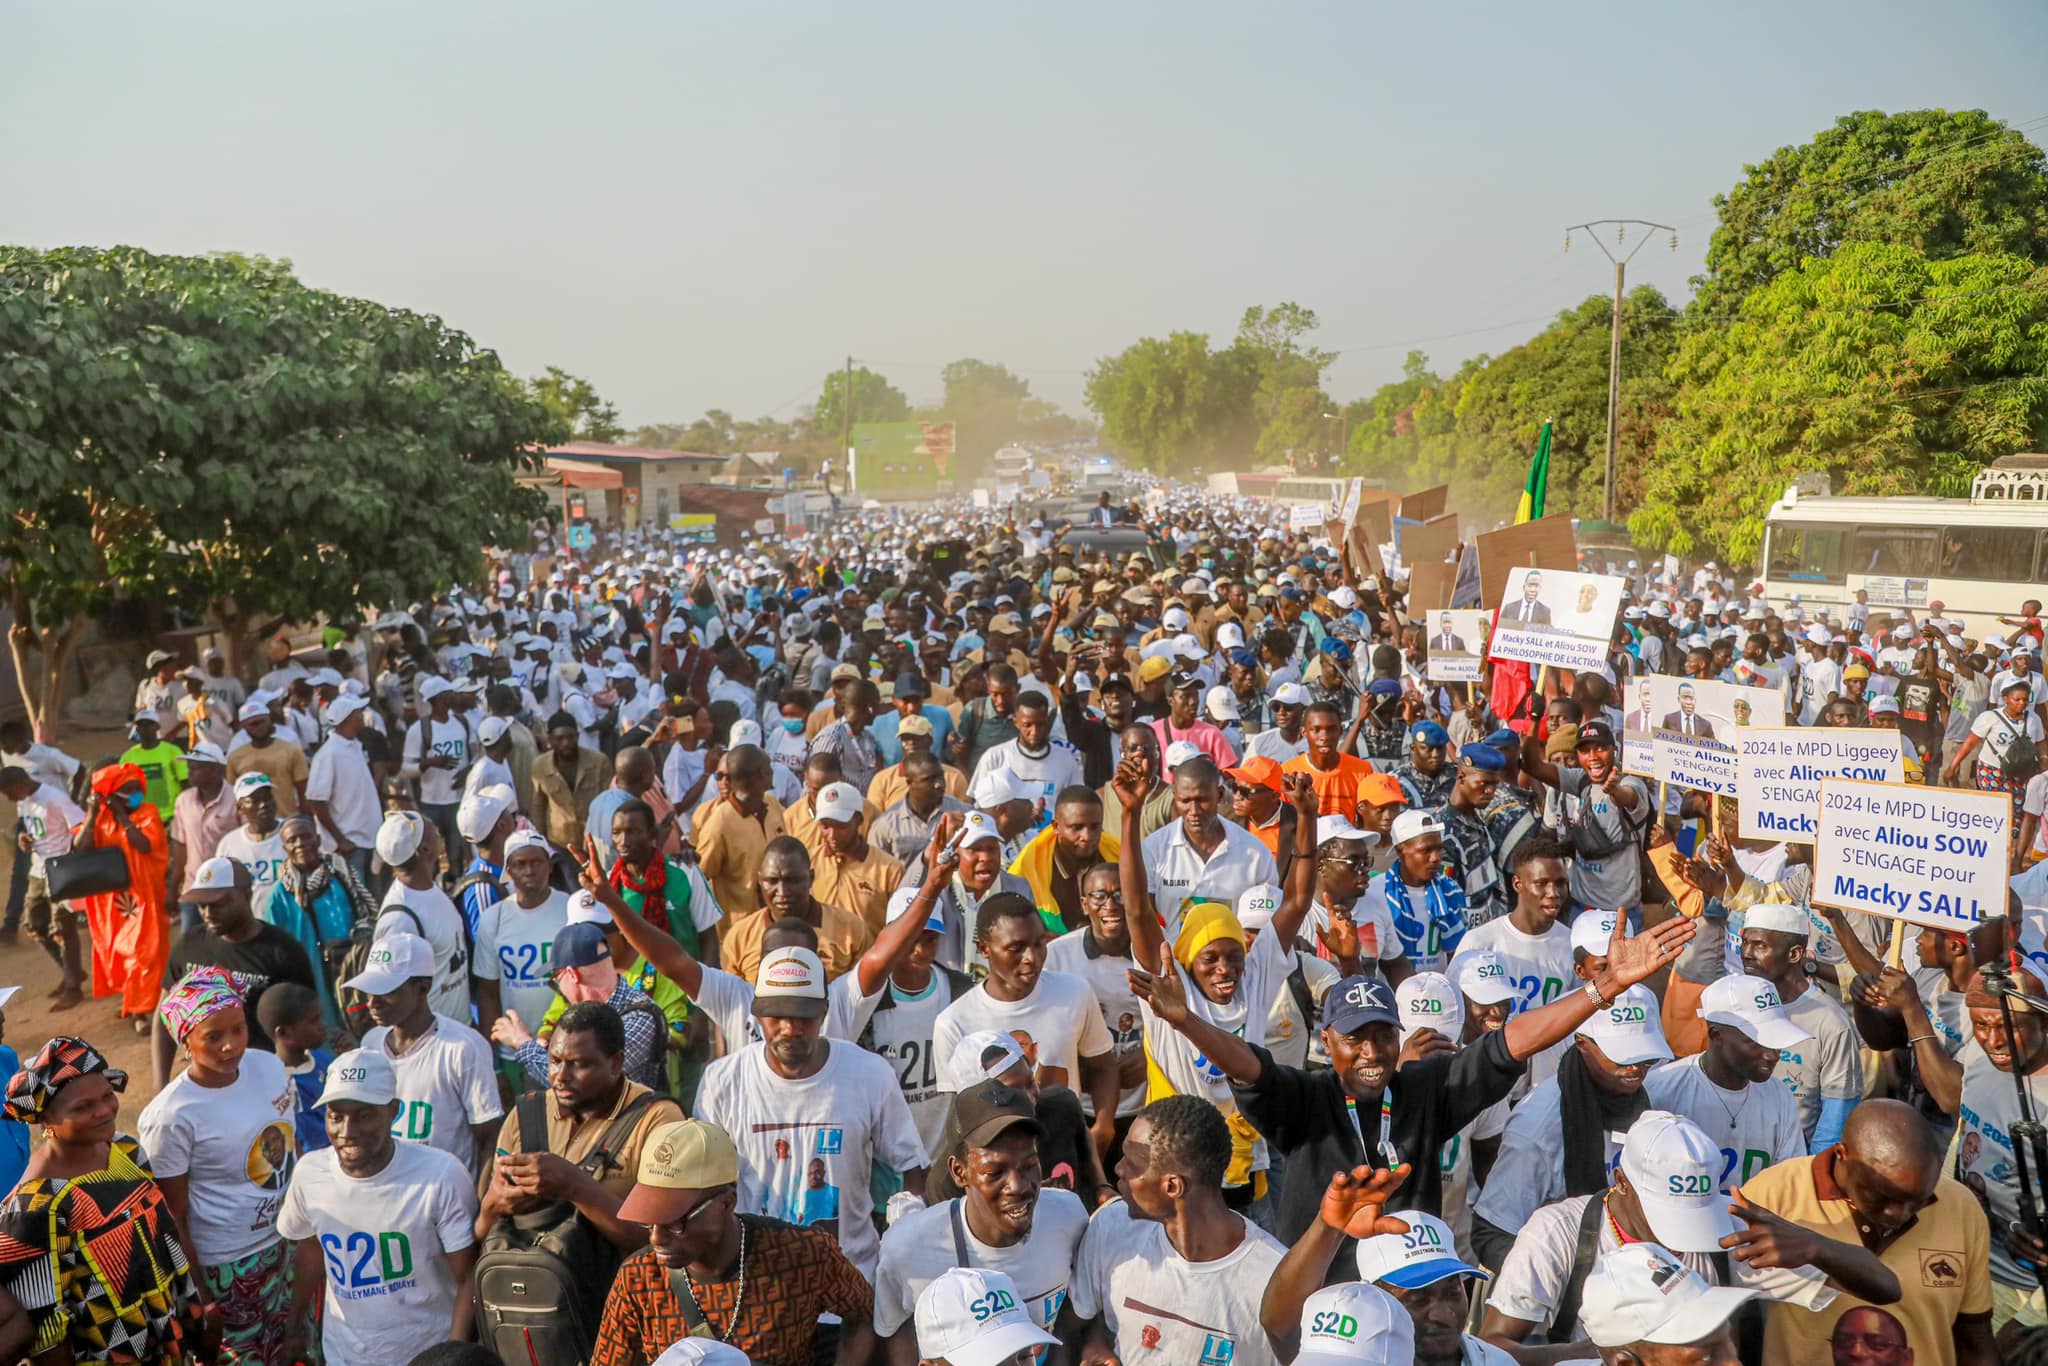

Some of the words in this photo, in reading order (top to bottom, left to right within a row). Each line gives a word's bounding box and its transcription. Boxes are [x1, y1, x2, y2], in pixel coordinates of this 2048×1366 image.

[1526, 636, 1544, 647] SALL
[1576, 643, 1598, 654] SOW
[1503, 646, 1554, 662] PHILOSOPHIE
[1554, 653, 1565, 663] DE
[1667, 747, 1692, 757] avec
[1695, 750, 1731, 765] Aliou
[1743, 741, 1776, 755] 2024
[1780, 742, 1792, 756] le
[1797, 742, 1832, 757] MPD
[1837, 743, 1898, 762] Liggeey
[1674, 758, 1730, 776] S'ENGAGE
[1754, 768, 1785, 780] avec
[1671, 771, 1722, 792] Macky
[1825, 793, 1862, 812] 2024
[1866, 797, 1881, 814] le
[1885, 800, 1926, 819] MPD
[1931, 805, 2004, 834] Liggeey
[1834, 825, 1871, 841] avec
[1874, 826, 1928, 850] Aliou
[1934, 834, 1988, 858] SOW
[1842, 847, 1925, 876] S'ENGAGE
[1931, 865, 1976, 884] pour
[1249, 898, 1275, 910] S2D
[1834, 875, 1911, 913] Macky
[1917, 891, 1983, 923] SALL
[369, 950, 392, 963] S2D
[1478, 964, 1504, 977] S2D
[1411, 999, 1442, 1013] S2D
[1754, 992, 1781, 1009] S2D
[1610, 1006, 1645, 1023] S2D
[340, 1068, 367, 1081] S2D
[1669, 1175, 1711, 1193] S2D
[321, 1231, 413, 1288] S2D
[970, 1289, 1015, 1321] S2D
[1311, 1311, 1358, 1338] S2D
